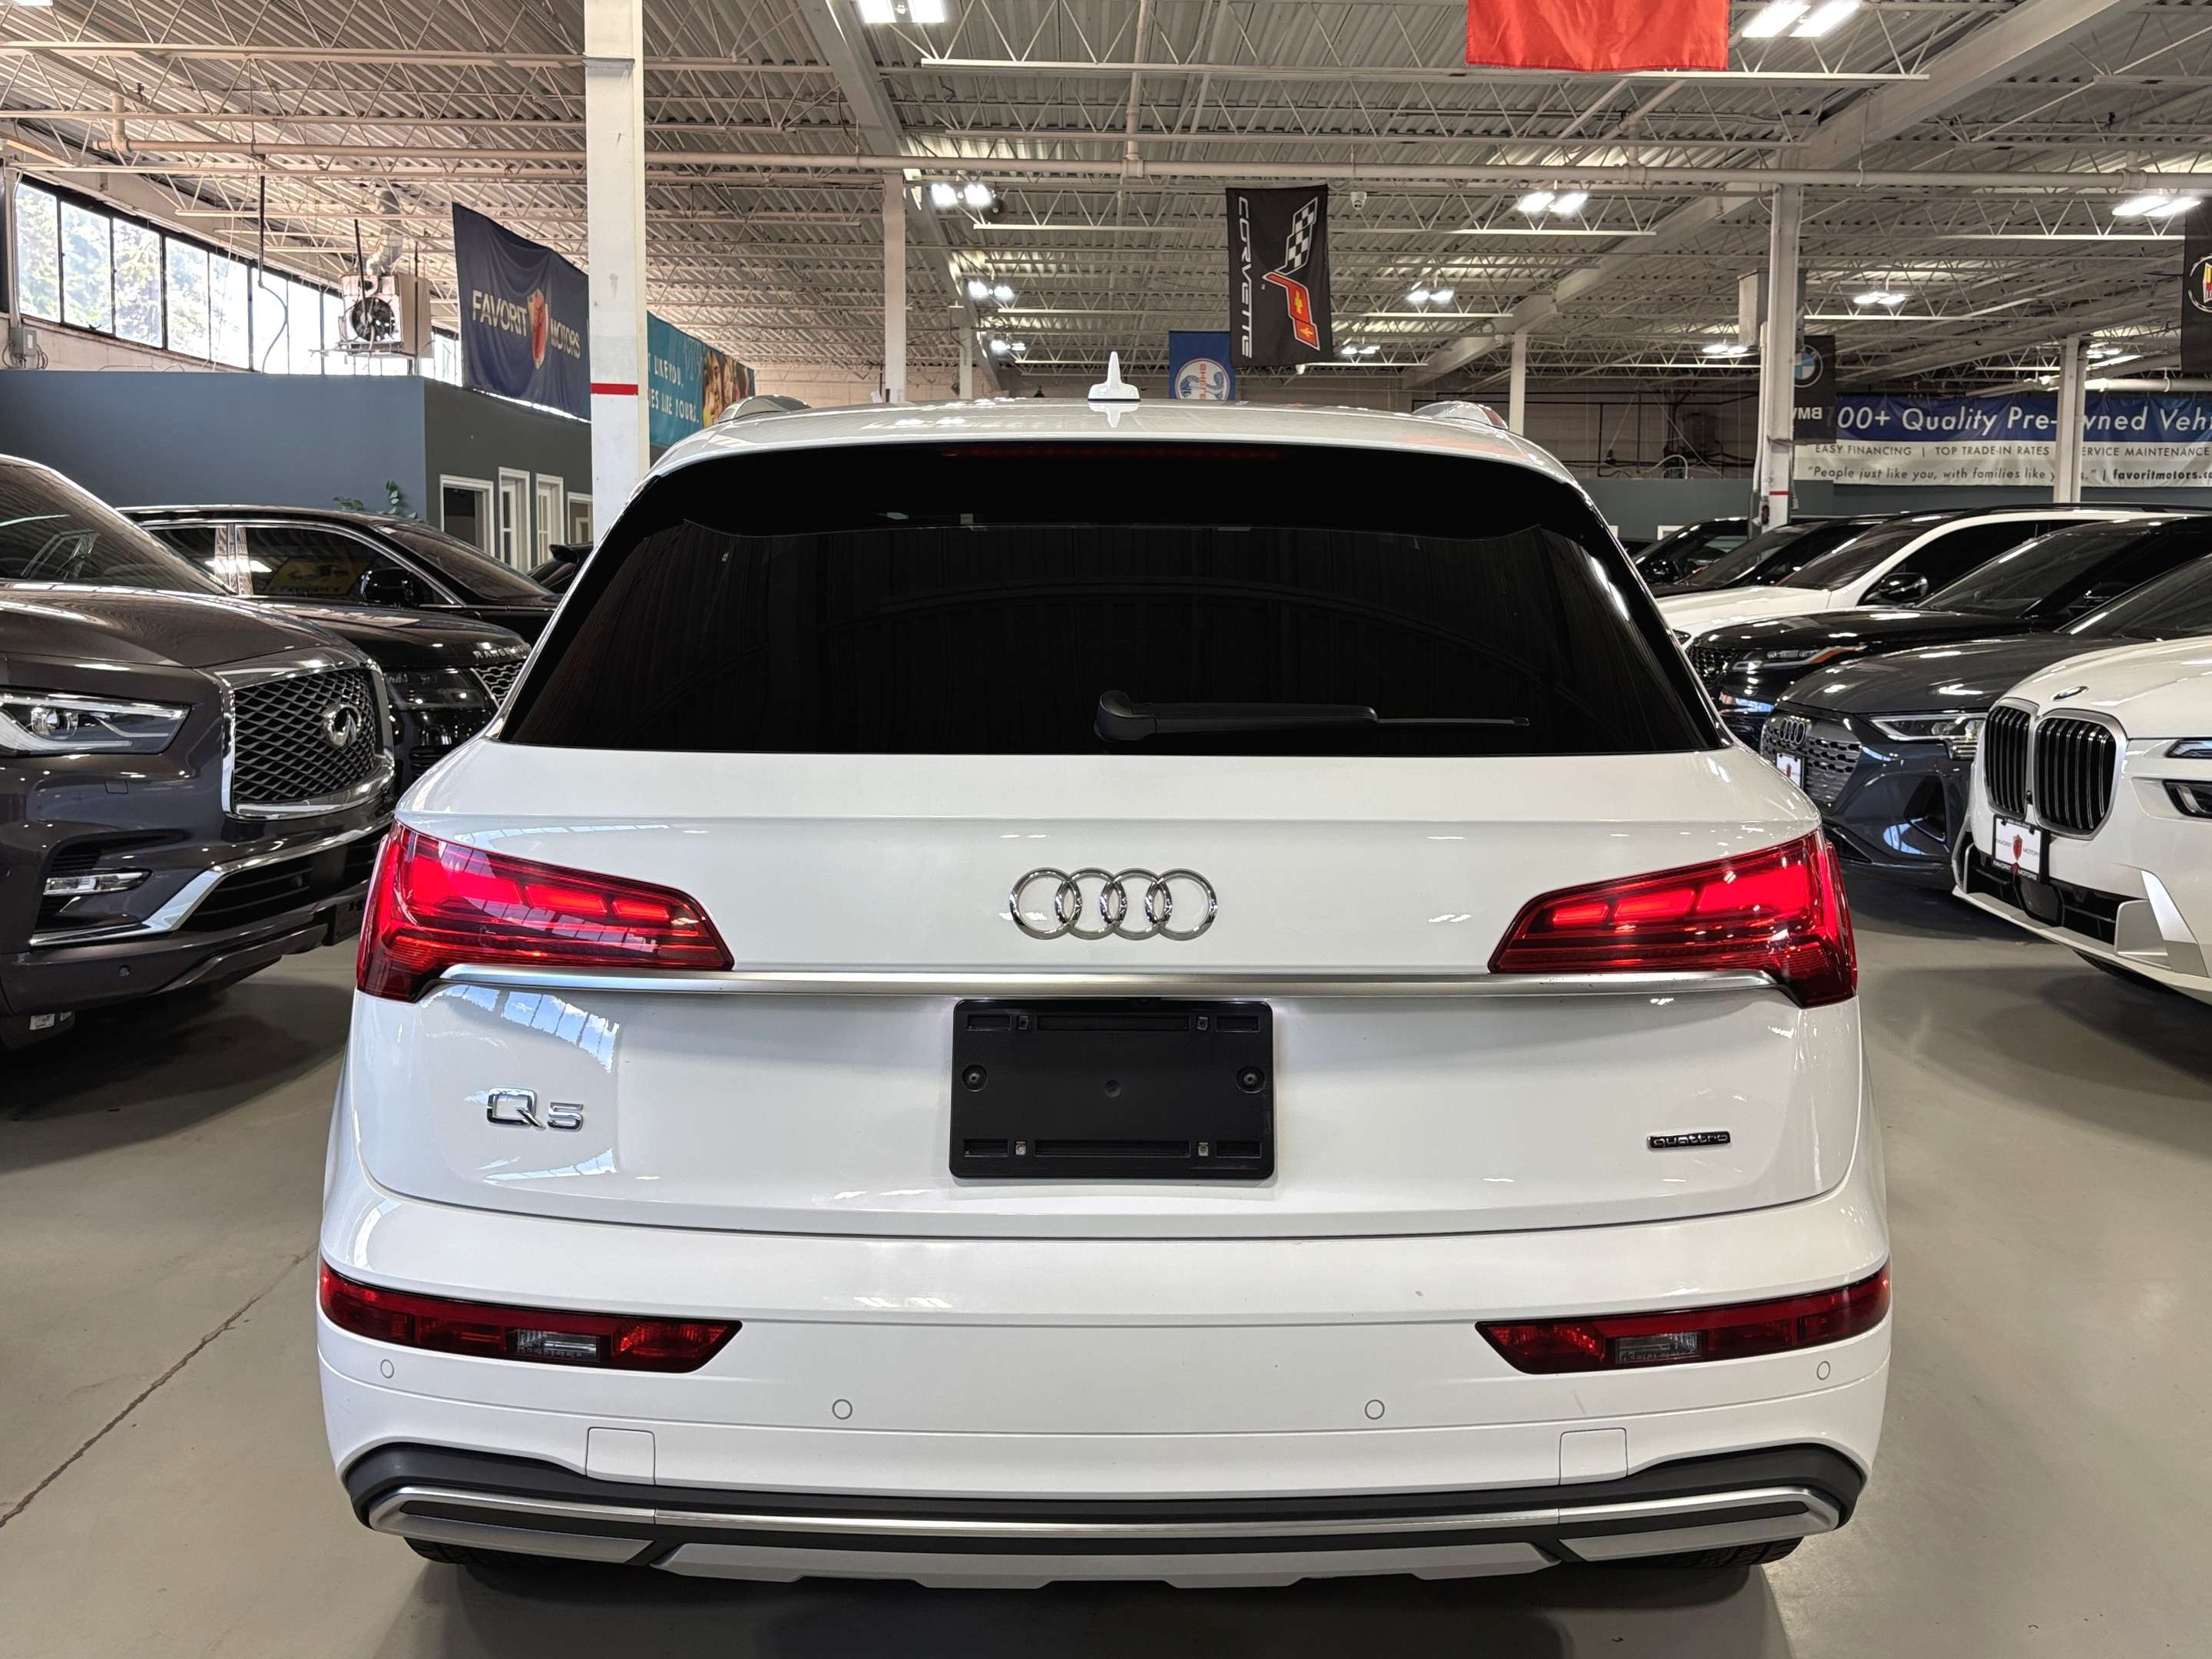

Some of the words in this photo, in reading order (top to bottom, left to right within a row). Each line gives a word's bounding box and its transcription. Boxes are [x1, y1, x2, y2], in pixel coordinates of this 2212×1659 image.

[1239, 197, 1253, 358] CORVETTE
[472, 289, 528, 336] FAVORIT
[550, 317, 581, 359] MOTORS
[1836, 406, 1890, 429] 00+
[1902, 406, 1997, 436] Quality
[1815, 445, 1843, 455] EASY
[1848, 445, 1912, 455] FINANCING
[1935, 447, 1957, 455] TOP
[1962, 445, 2012, 455] TRADE-IN
[2017, 445, 2050, 455] RATES
[2081, 447, 2120, 456] ERVICE
[2124, 447, 2210, 456] MAINTENANCE
[1859, 468, 1883, 480] just
[1886, 468, 1909, 479] like
[1912, 470, 1938, 482] you,
[1943, 467, 1967, 479] with
[1972, 466, 2020, 479] families
[2025, 467, 2045, 479] like
[486, 1087, 584, 1132] Q5
[1653, 1134, 1728, 1148] quattro
